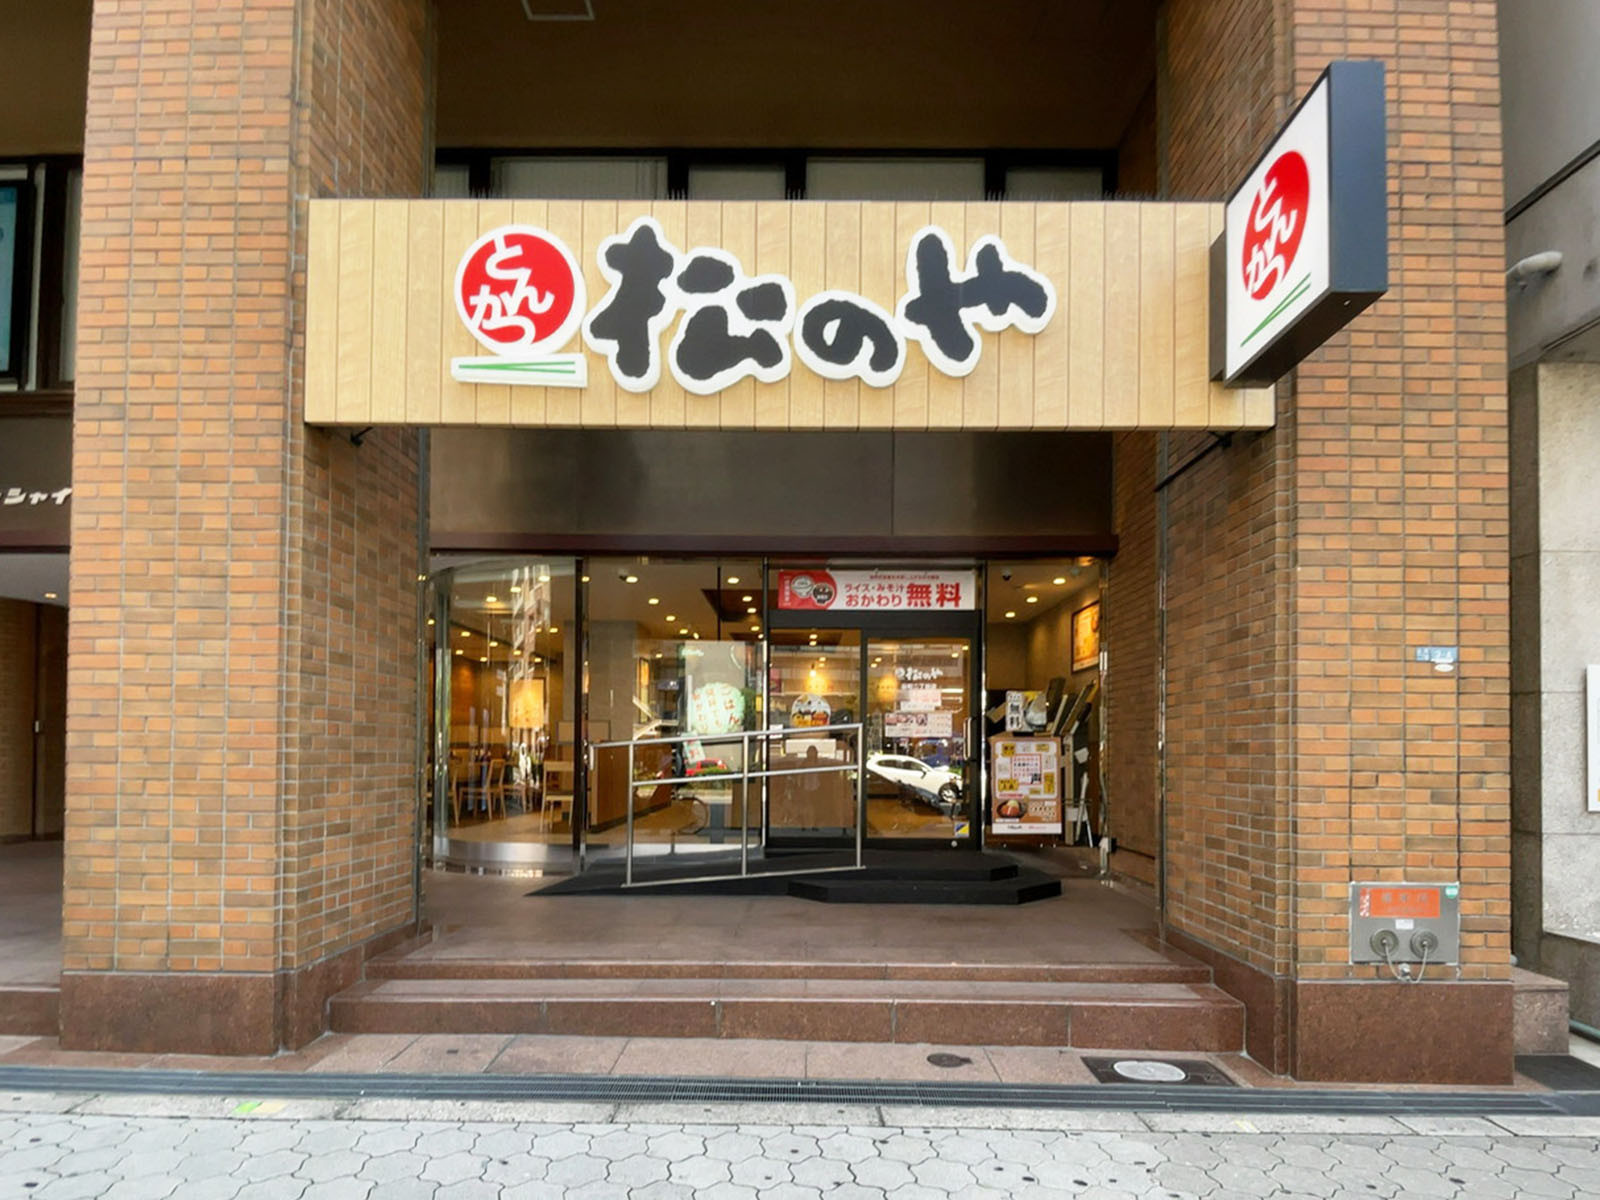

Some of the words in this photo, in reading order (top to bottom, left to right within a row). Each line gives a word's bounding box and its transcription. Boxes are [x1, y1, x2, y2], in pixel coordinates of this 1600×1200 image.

[589, 224, 1048, 381] 松のや
[0, 487, 72, 505] シャイ
[845, 594, 903, 607] おかわり
[906, 582, 962, 608] 無料
